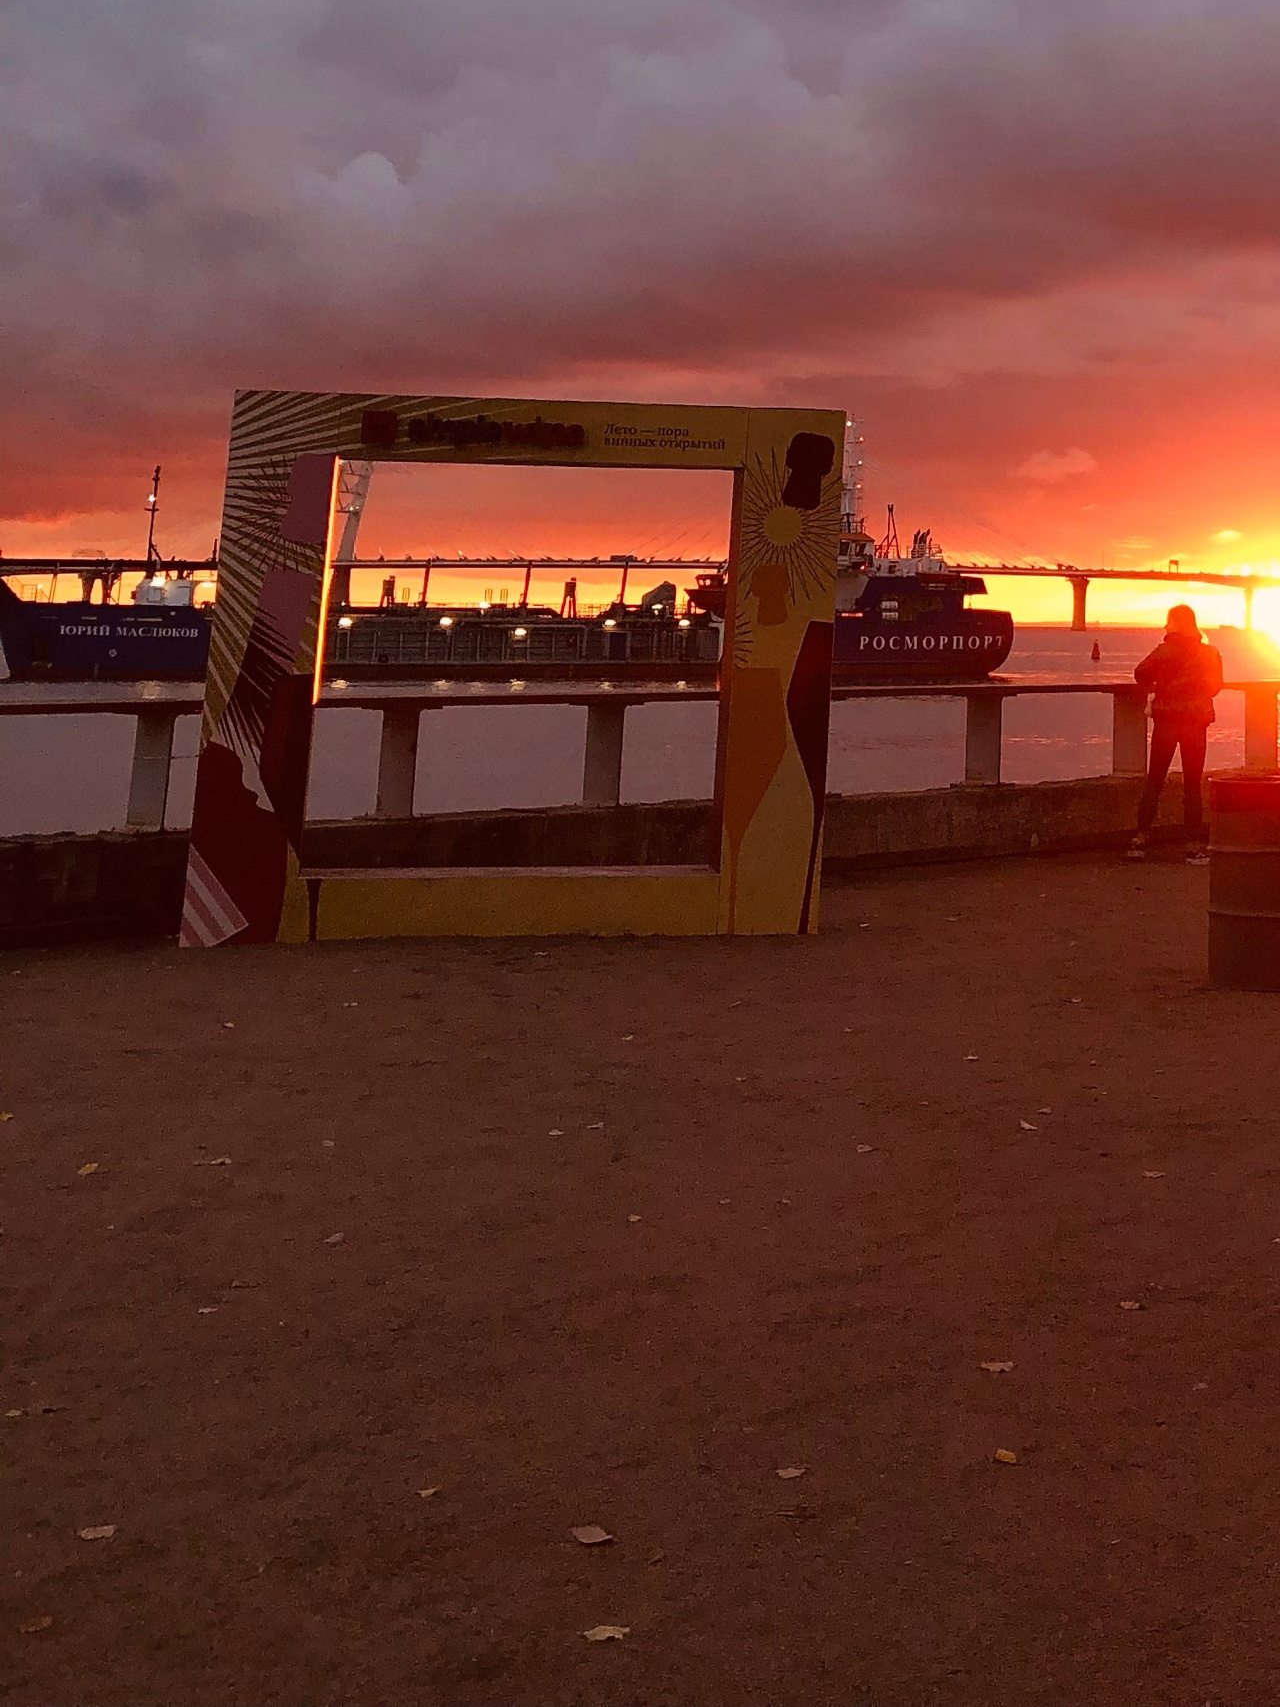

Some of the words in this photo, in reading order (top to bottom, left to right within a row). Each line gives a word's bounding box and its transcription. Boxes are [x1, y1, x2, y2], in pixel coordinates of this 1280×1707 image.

[603, 424, 637, 435] Лето
[658, 427, 689, 439] пора
[604, 437, 656, 448] винных
[659, 439, 726, 451] открытий
[60, 624, 110, 636] ЮРИЙ
[116, 626, 198, 638] МАСЛЮКОВ
[859, 635, 1005, 650] РОСМОРПОРТ
